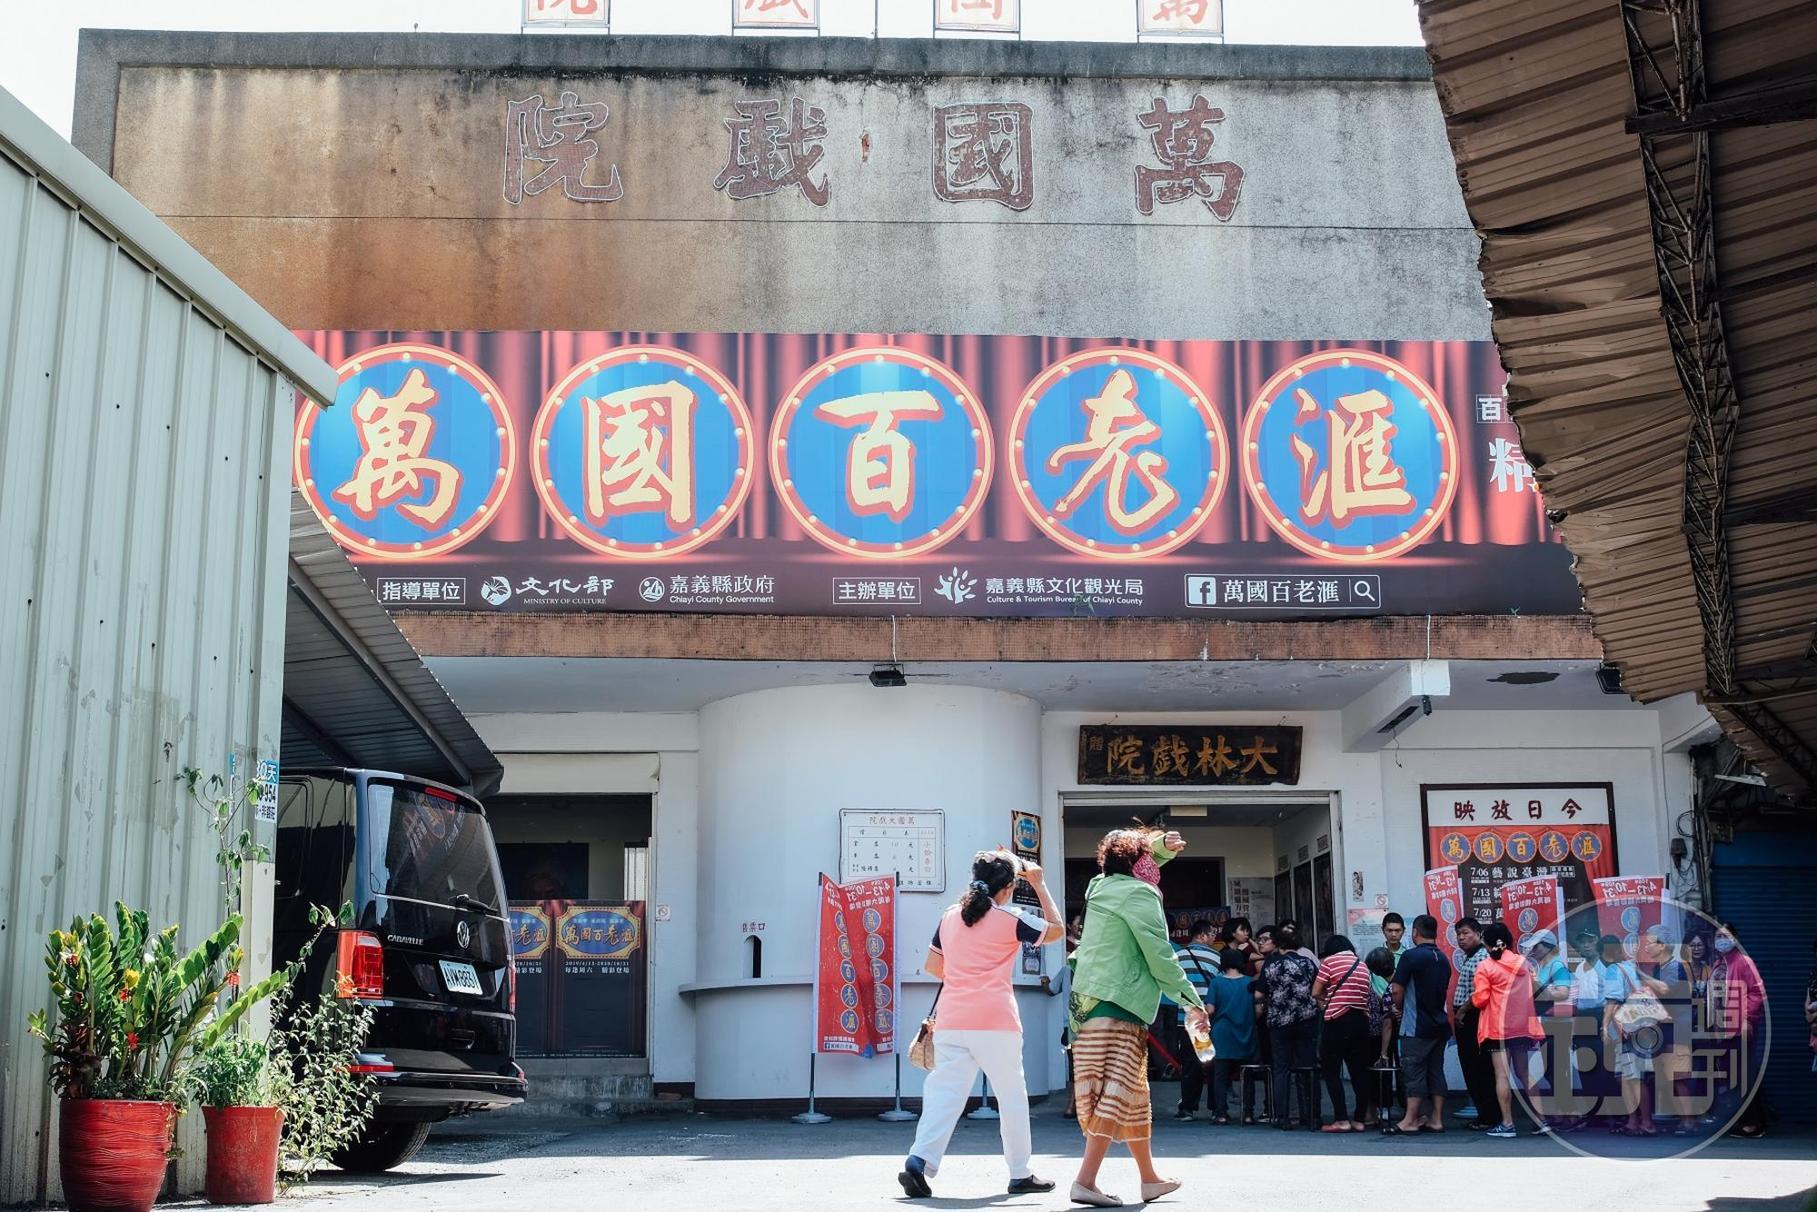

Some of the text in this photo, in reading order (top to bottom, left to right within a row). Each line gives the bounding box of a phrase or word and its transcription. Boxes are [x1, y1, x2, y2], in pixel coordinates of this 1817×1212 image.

[515, 575, 615, 596] 文化部
[669, 574, 775, 594] 嘉義縣政府
[985, 577, 1144, 596] 嘉義縣文化觀光局
[381, 581, 461, 601] 指導單位
[838, 581, 916, 600] 主辦單位
[669, 595, 775, 605] Chiayi County Government
[986, 595, 1014, 603] Culture
[1023, 595, 1054, 603] Tourism
[1055, 595, 1083, 604] Burea
[1092, 596, 1115, 605] Chiayi
[1116, 597, 1143, 606] County
[1470, 866, 1489, 877] 7/06
[1471, 887, 1491, 897] 7/13
[1473, 907, 1492, 917] 7/20
[387, 934, 424, 946] CARAVELLE
